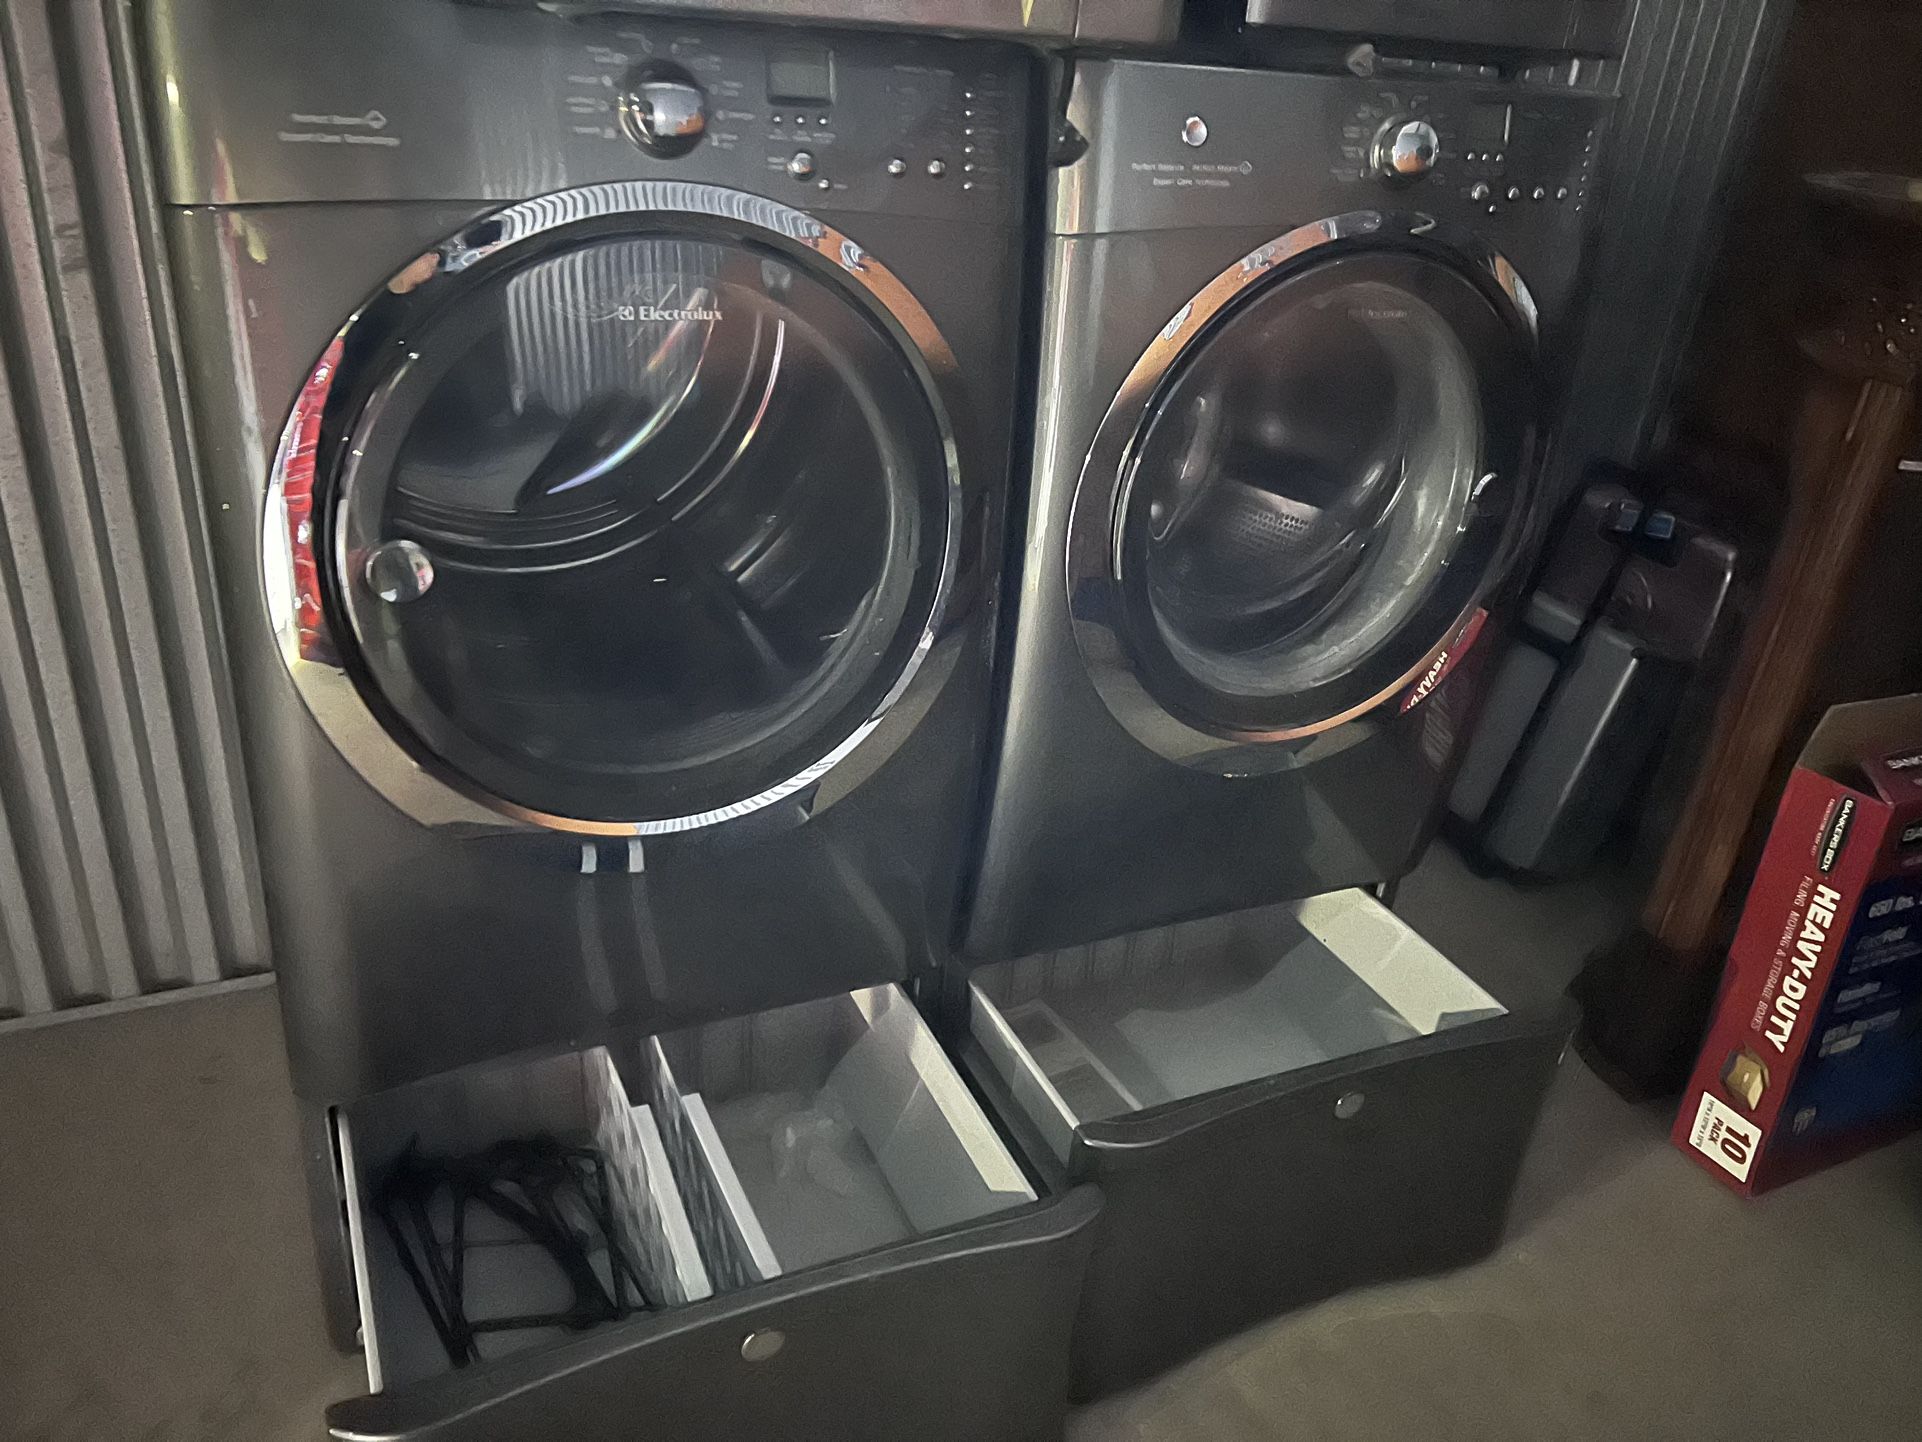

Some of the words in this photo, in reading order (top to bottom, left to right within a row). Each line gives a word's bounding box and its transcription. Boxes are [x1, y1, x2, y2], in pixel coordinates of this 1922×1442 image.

[639, 305, 723, 321] Electrolux
[1829, 799, 1854, 849] BANKERS
[1820, 848, 1835, 872] BOX
[1779, 910, 1801, 949] MOVING
[1761, 957, 1783, 999] STORAGE
[1764, 883, 1841, 1053] HEAVY-DUTY
[1750, 1000, 1769, 1032] BOXES
[1708, 1116, 1725, 1145] PACK
[1720, 1125, 1752, 1165] 10
